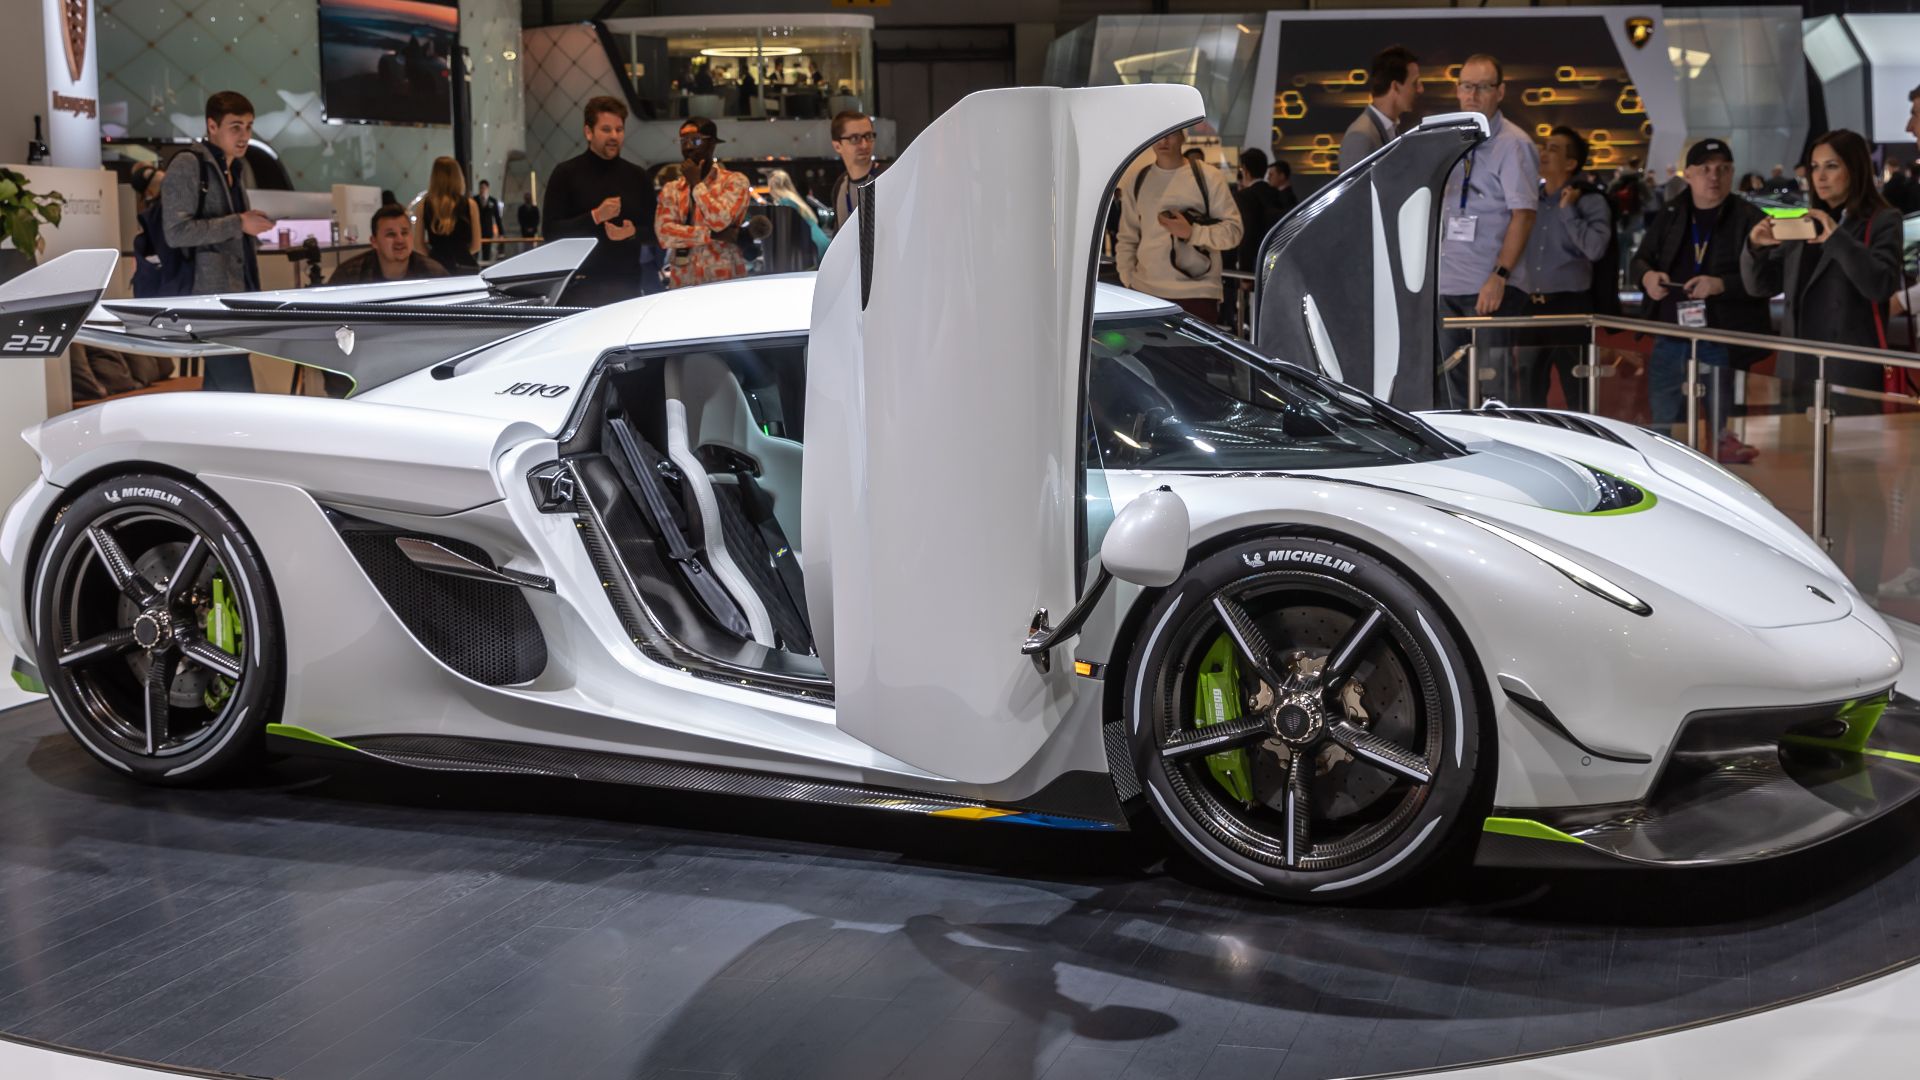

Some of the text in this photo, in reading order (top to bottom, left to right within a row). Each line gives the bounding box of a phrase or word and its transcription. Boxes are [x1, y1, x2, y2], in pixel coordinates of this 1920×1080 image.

[3, 334, 63, 353] 251
[121, 487, 183, 506] MICHELIN
[1267, 550, 1356, 574] MICHELIN
